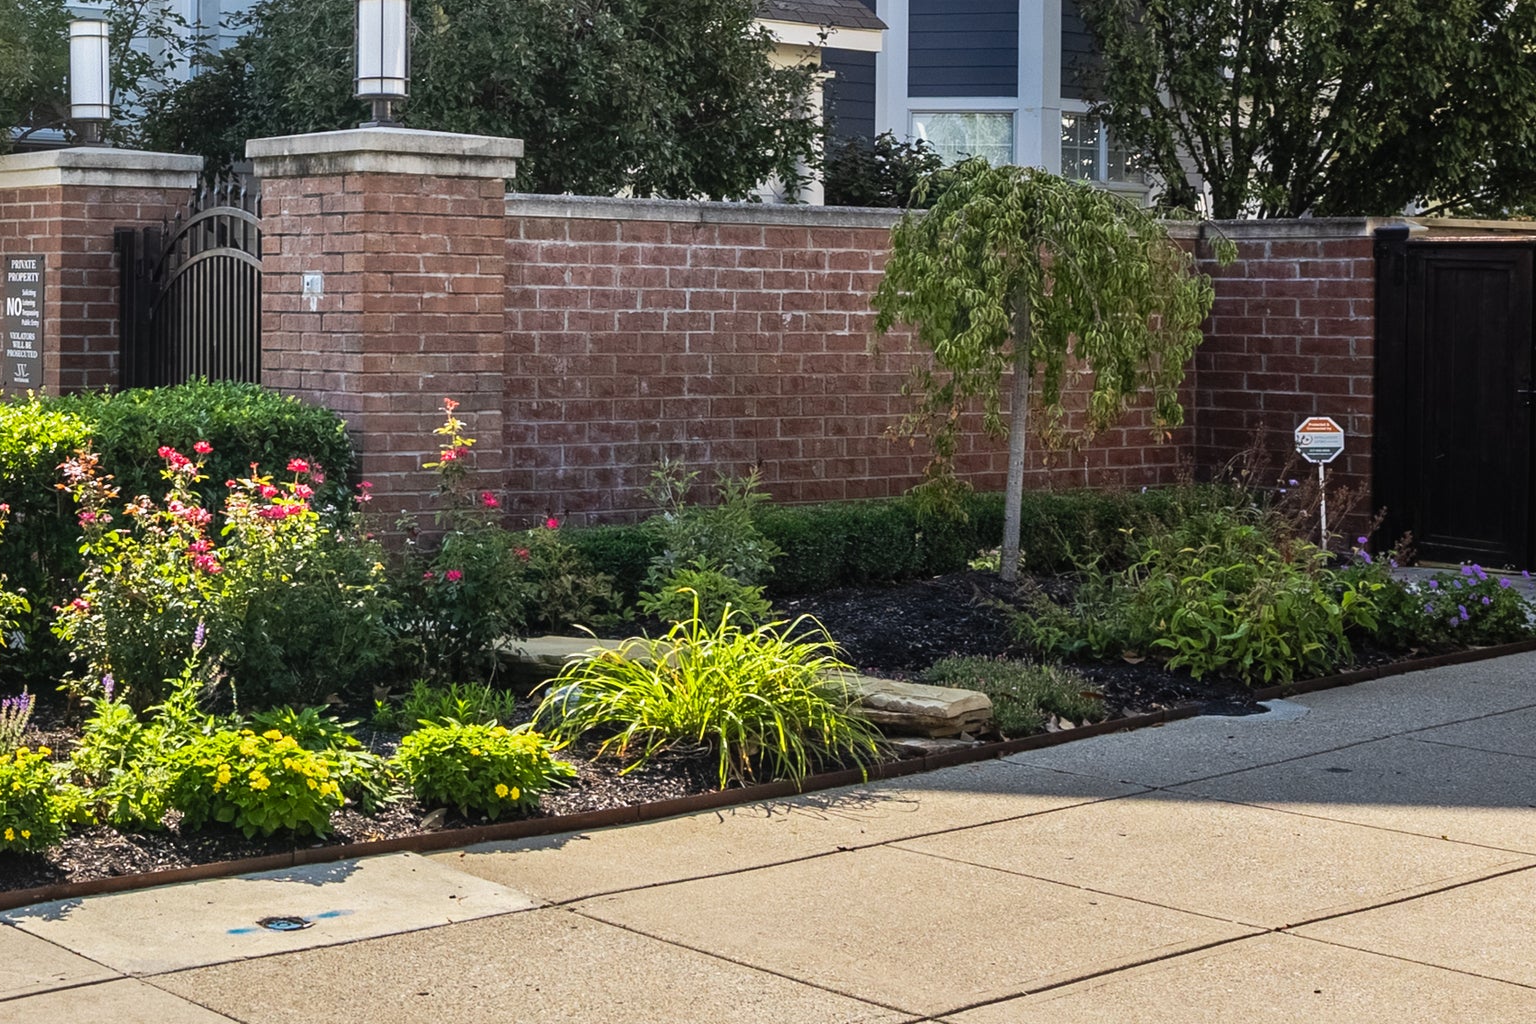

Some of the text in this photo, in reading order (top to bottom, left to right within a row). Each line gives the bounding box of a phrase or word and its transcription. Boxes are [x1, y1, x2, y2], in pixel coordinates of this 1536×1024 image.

[11, 259, 37, 269] PRIVATE
[7, 272, 40, 282] PROPERTY
[6, 297, 22, 316] NO
[9, 331, 36, 340] VIOLATORS
[12, 340, 32, 349] WILL BE
[6, 349, 39, 359] PROSECUTED
